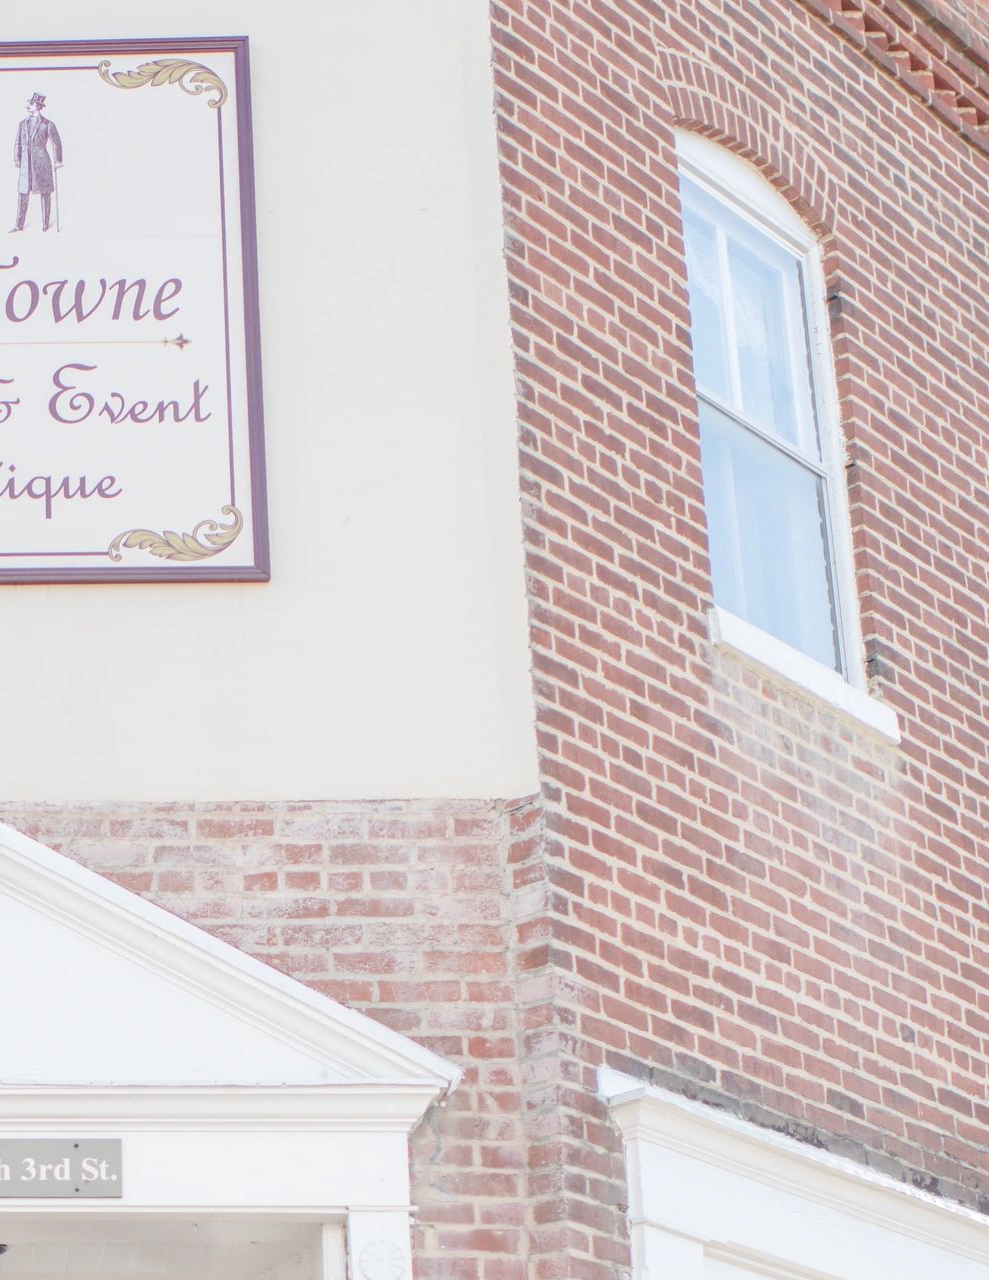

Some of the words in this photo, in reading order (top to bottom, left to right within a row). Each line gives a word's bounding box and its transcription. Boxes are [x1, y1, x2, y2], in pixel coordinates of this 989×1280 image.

[48, 363, 212, 424] Event
[20, 1157, 71, 1181] 3rd
[81, 1157, 118, 1181] St.
